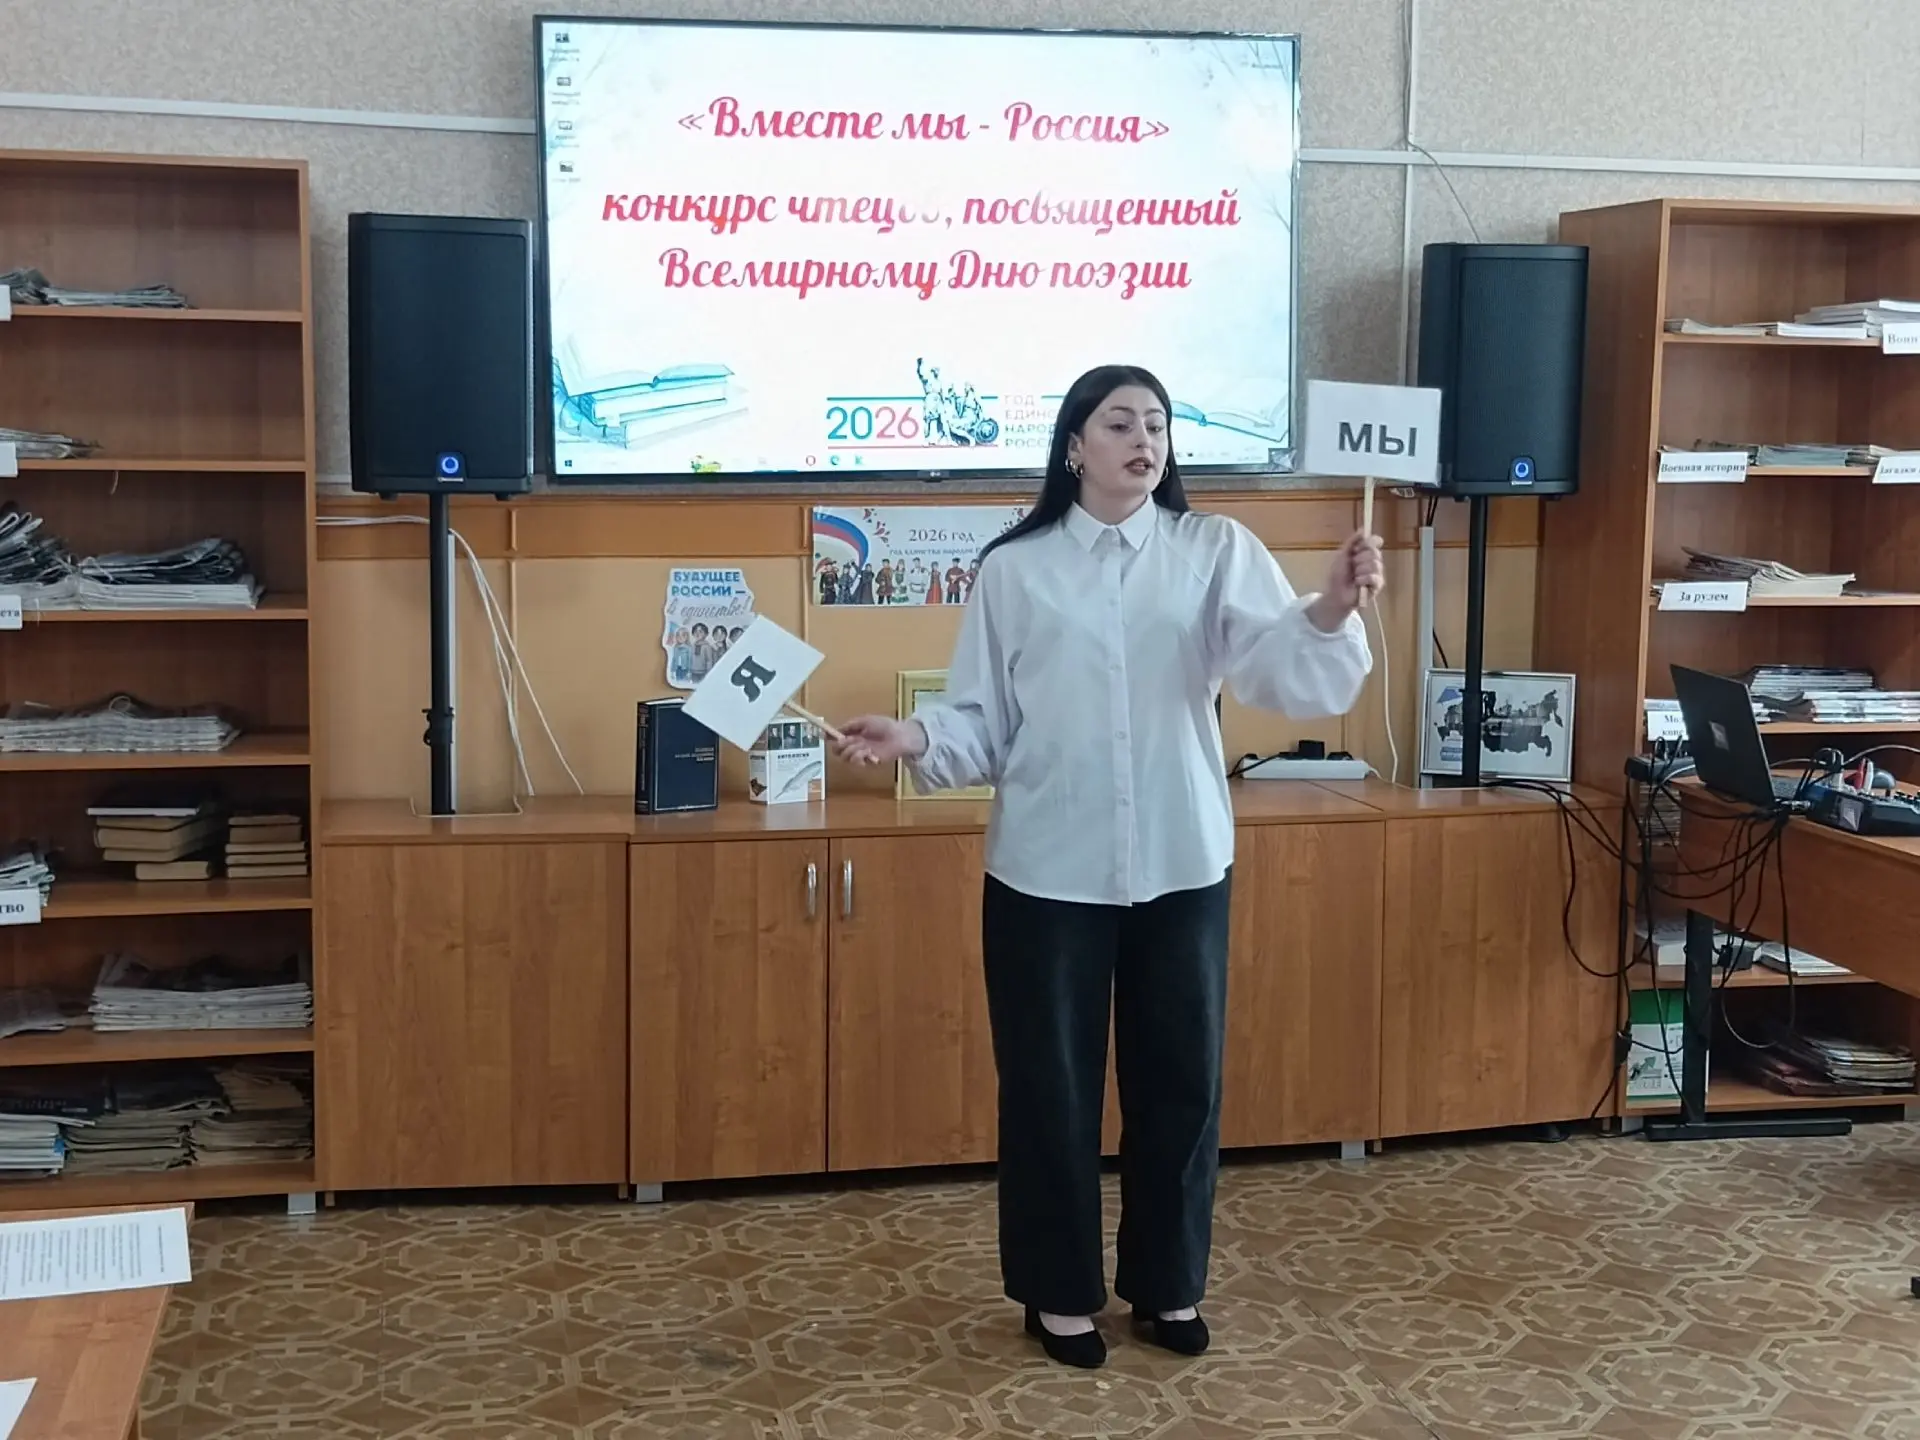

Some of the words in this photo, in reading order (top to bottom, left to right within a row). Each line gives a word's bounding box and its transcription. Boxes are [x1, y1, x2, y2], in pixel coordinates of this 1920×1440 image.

[678, 96, 884, 140] «Вместе
[892, 112, 970, 140] мы
[1004, 101, 1170, 143] Россия»
[602, 194, 778, 235] конкурс
[963, 188, 1241, 236] посвященный
[659, 248, 941, 300] Всемирному
[948, 249, 1047, 289] Дню
[1050, 262, 1192, 300] поэзии
[1004, 394, 1035, 406] ГОД
[826, 406, 919, 440] 2026
[1004, 423, 1056, 435] НАРОД
[1004, 438, 1048, 449] РОСС
[1704, 464, 1745, 474] история
[908, 528, 948, 543] 2026
[952, 530, 976, 544] год
[673, 571, 740, 583] БУДУЩЕЕ
[671, 586, 732, 596] РОССИИ
[731, 655, 777, 703] Я
